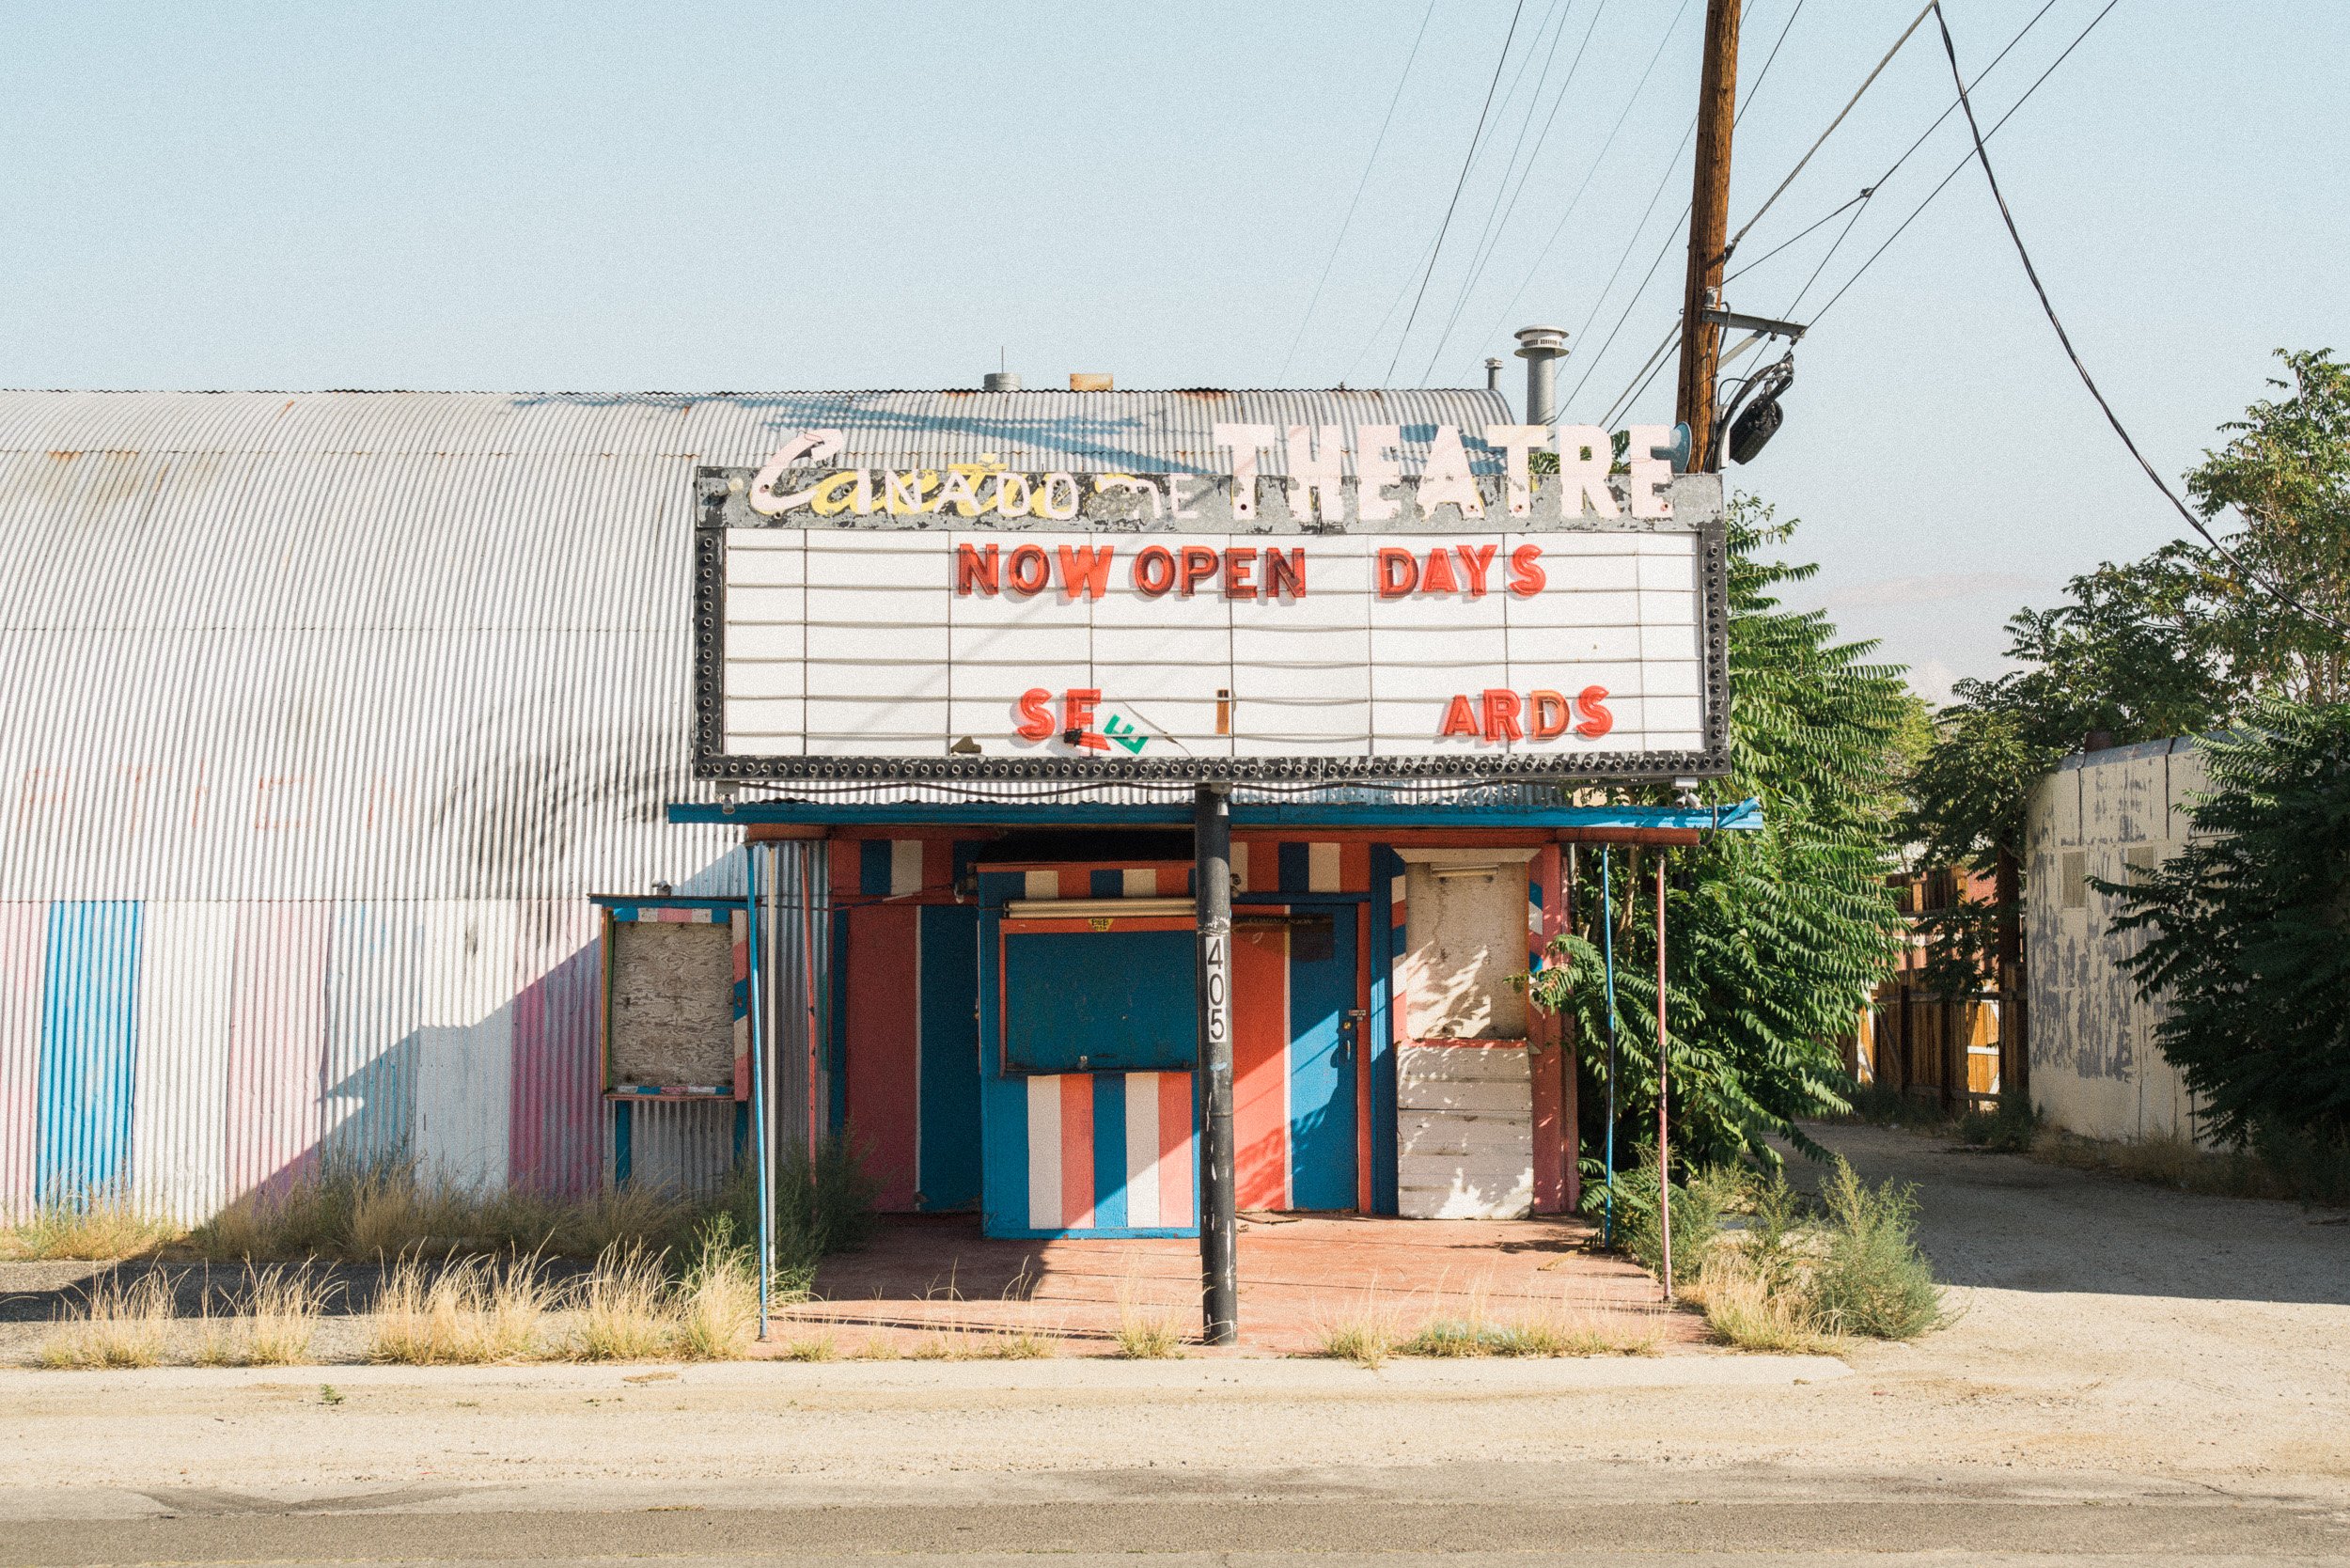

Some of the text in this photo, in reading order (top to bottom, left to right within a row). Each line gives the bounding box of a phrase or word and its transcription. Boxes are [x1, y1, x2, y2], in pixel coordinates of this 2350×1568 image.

[1214, 423, 1674, 522] THEATRE
[958, 543, 1547, 600] NOW OPEN DAYS
[1441, 684, 1614, 743] ARDS
[1207, 938, 1225, 1041] 405
